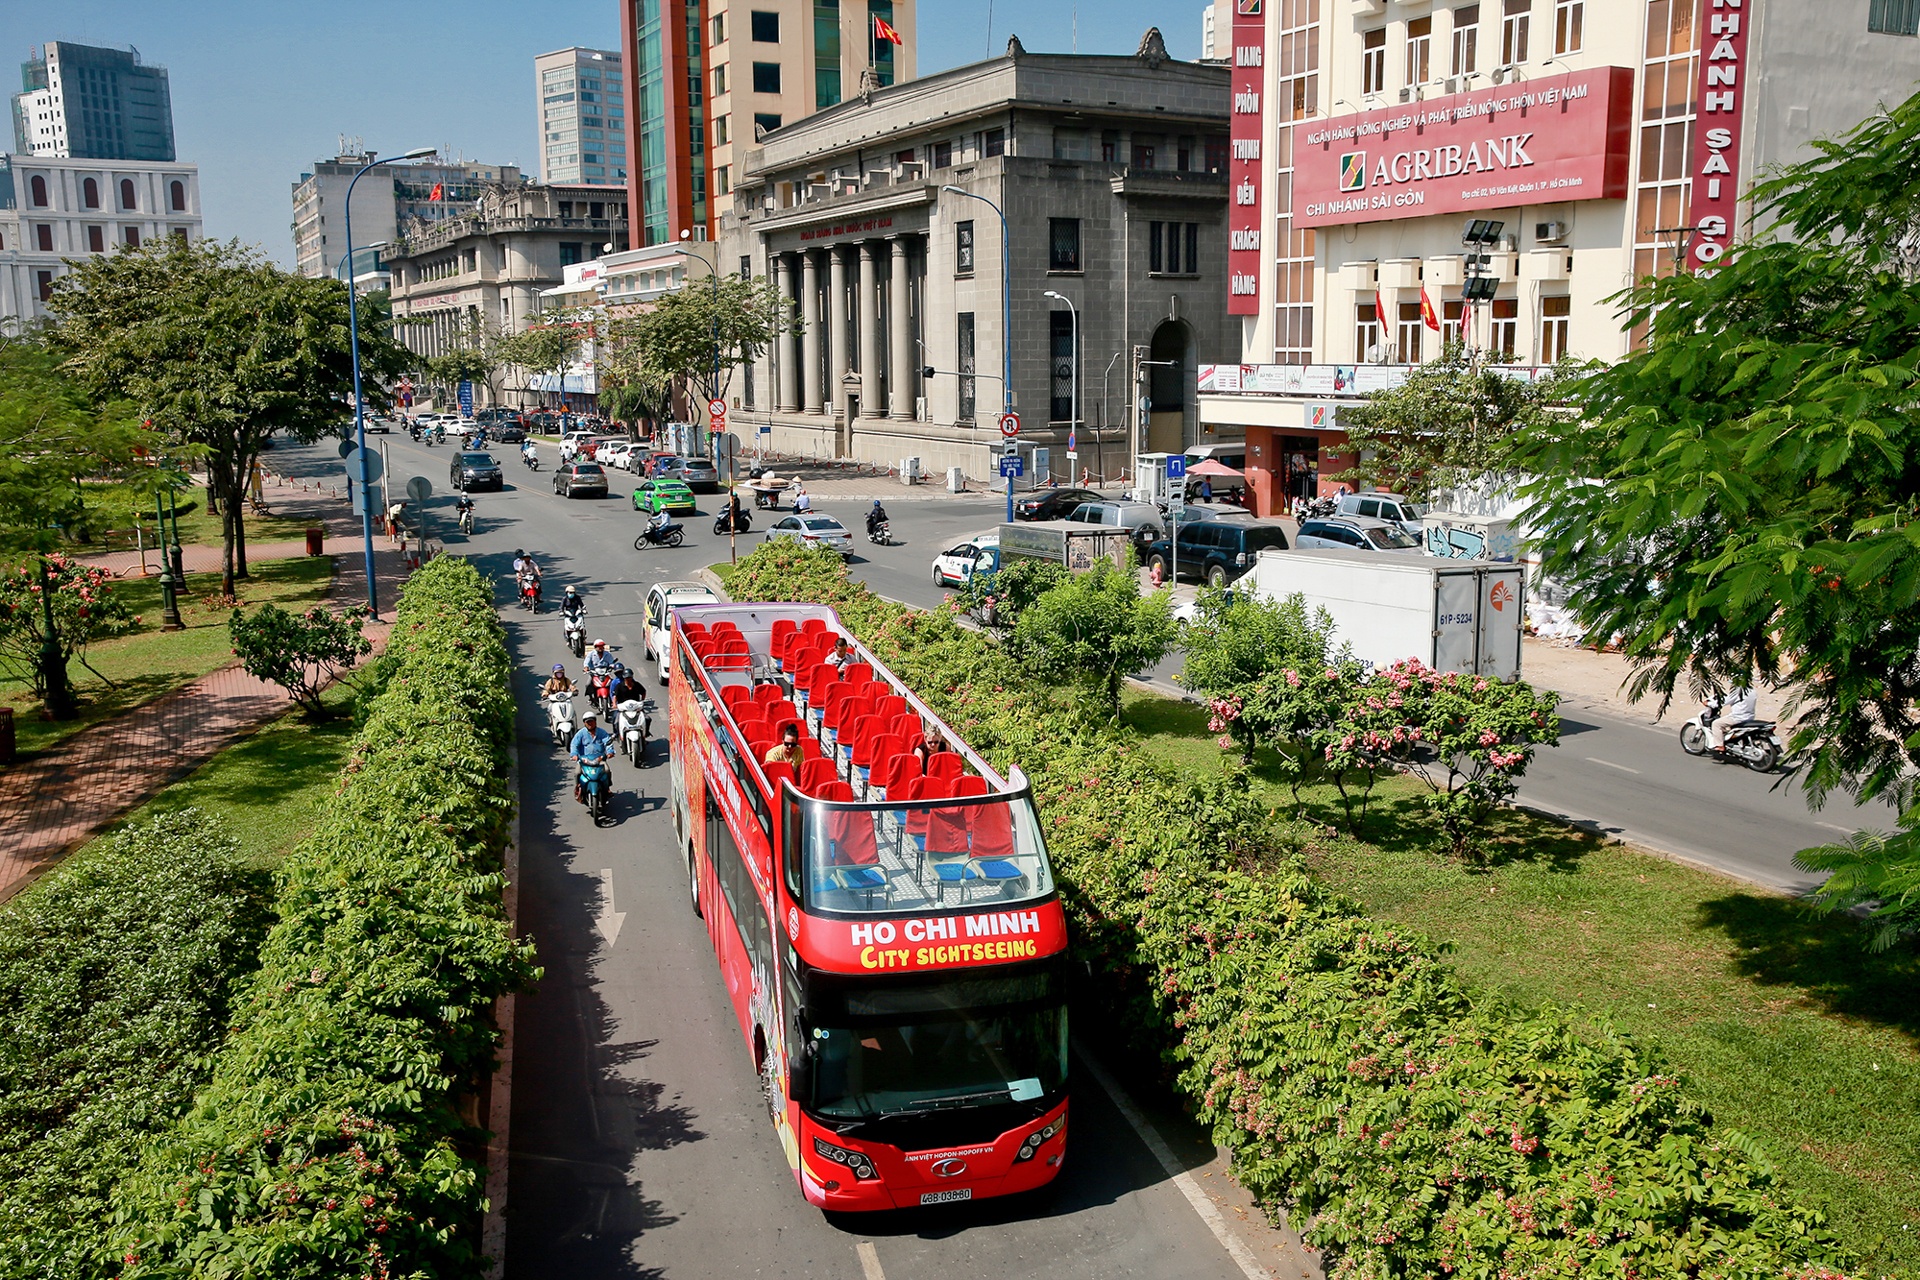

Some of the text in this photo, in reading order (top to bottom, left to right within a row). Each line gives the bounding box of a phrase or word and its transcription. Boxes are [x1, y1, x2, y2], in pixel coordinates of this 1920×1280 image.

[1236, 46, 1262, 67] MANG
[1235, 84, 1259, 113] PHỒN
[1307, 84, 1588, 145] NGÂN HÀNG NÔNG NGHIỆP VÀ PHÁT TRIỂN NÔNG THÔN VIỆT NAM
[1233, 139, 1260, 165] THỊNH
[1371, 132, 1534, 186] AGRIBANK
[1702, 128, 1732, 198] SÀI
[1237, 176, 1255, 205] ĐẾN
[1306, 188, 1425, 217] CHI NHÁNH SÀI GÒN
[1231, 225, 1260, 250] KHÁCH
[1232, 270, 1256, 294] HÀNG
[850, 911, 1040, 946] HO CHI MINH
[860, 938, 1037, 969] CITY SIGHTSEEING
